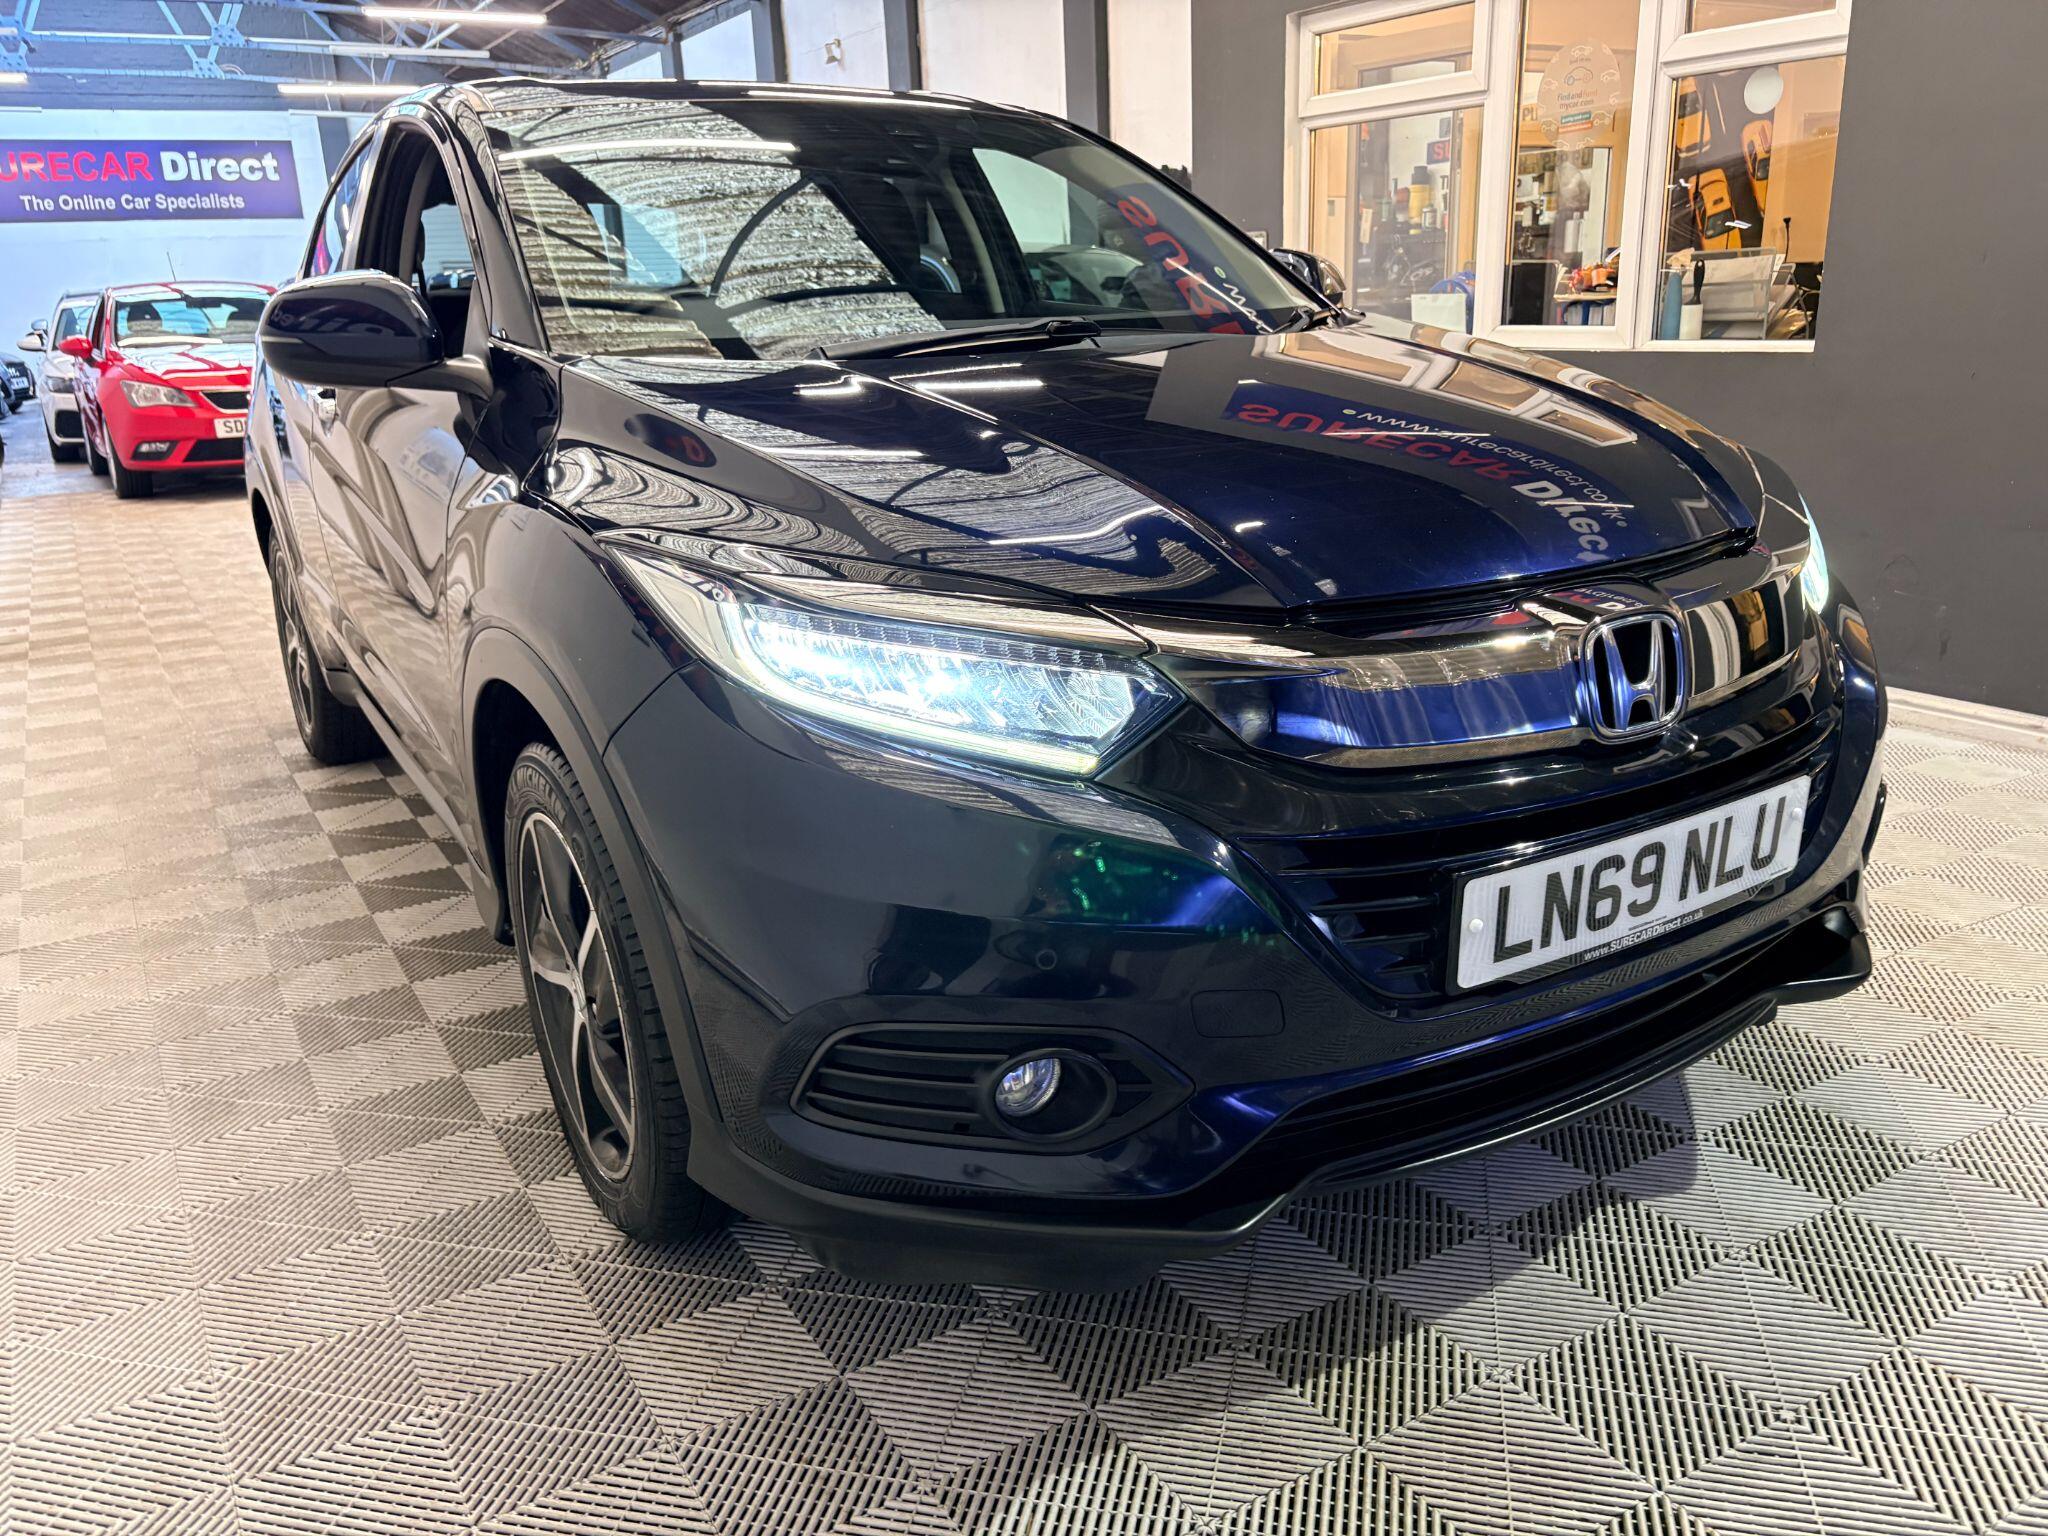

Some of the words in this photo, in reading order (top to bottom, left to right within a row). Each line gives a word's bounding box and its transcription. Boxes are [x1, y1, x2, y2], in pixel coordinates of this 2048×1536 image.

[160, 151, 280, 182] Direct
[20, 195, 54, 212] The
[58, 194, 116, 211] Online
[120, 193, 151, 210] Car
[155, 193, 245, 211] Specialists
[1493, 841, 1666, 964] LN69
[1678, 796, 1787, 901] NLU
